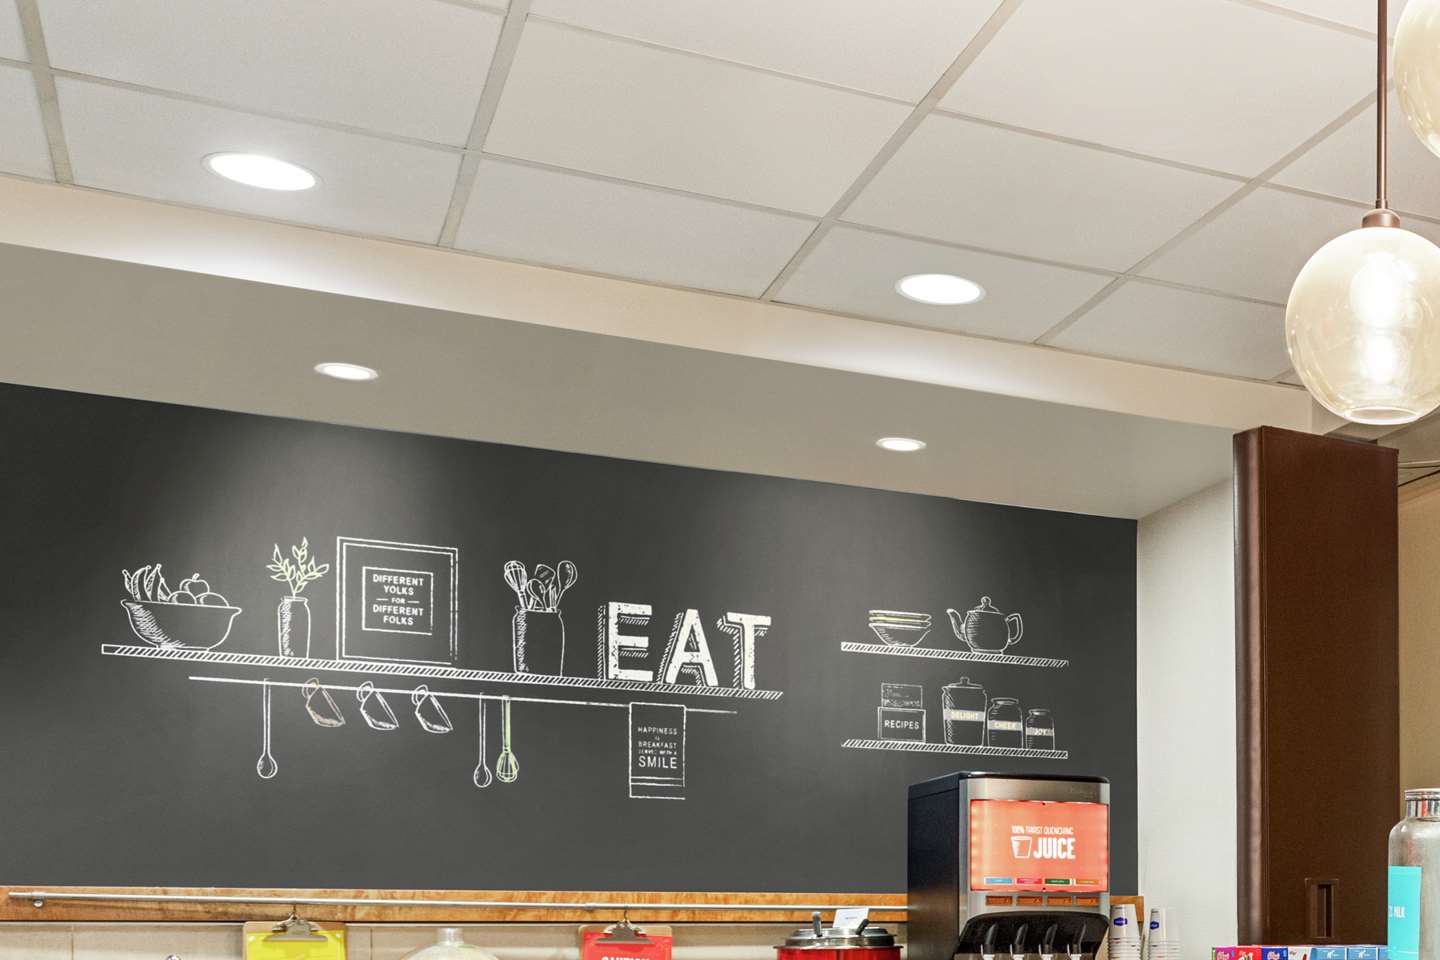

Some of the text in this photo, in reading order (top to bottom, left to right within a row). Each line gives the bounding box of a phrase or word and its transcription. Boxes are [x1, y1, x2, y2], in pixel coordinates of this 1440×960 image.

[372, 573, 424, 586] DIFFERENT
[383, 584, 415, 596] YOLKS
[391, 597, 406, 605] FOR
[372, 604, 424, 616] DIFFERENT
[383, 615, 414, 626] FOLKS
[604, 601, 772, 690] EAT
[637, 726, 678, 735] HAPPINESS
[884, 719, 920, 730] RECIPES
[638, 740, 678, 749] BREAKFAST
[638, 755, 678, 769] SMILE
[1033, 837, 1077, 860] JUICE
